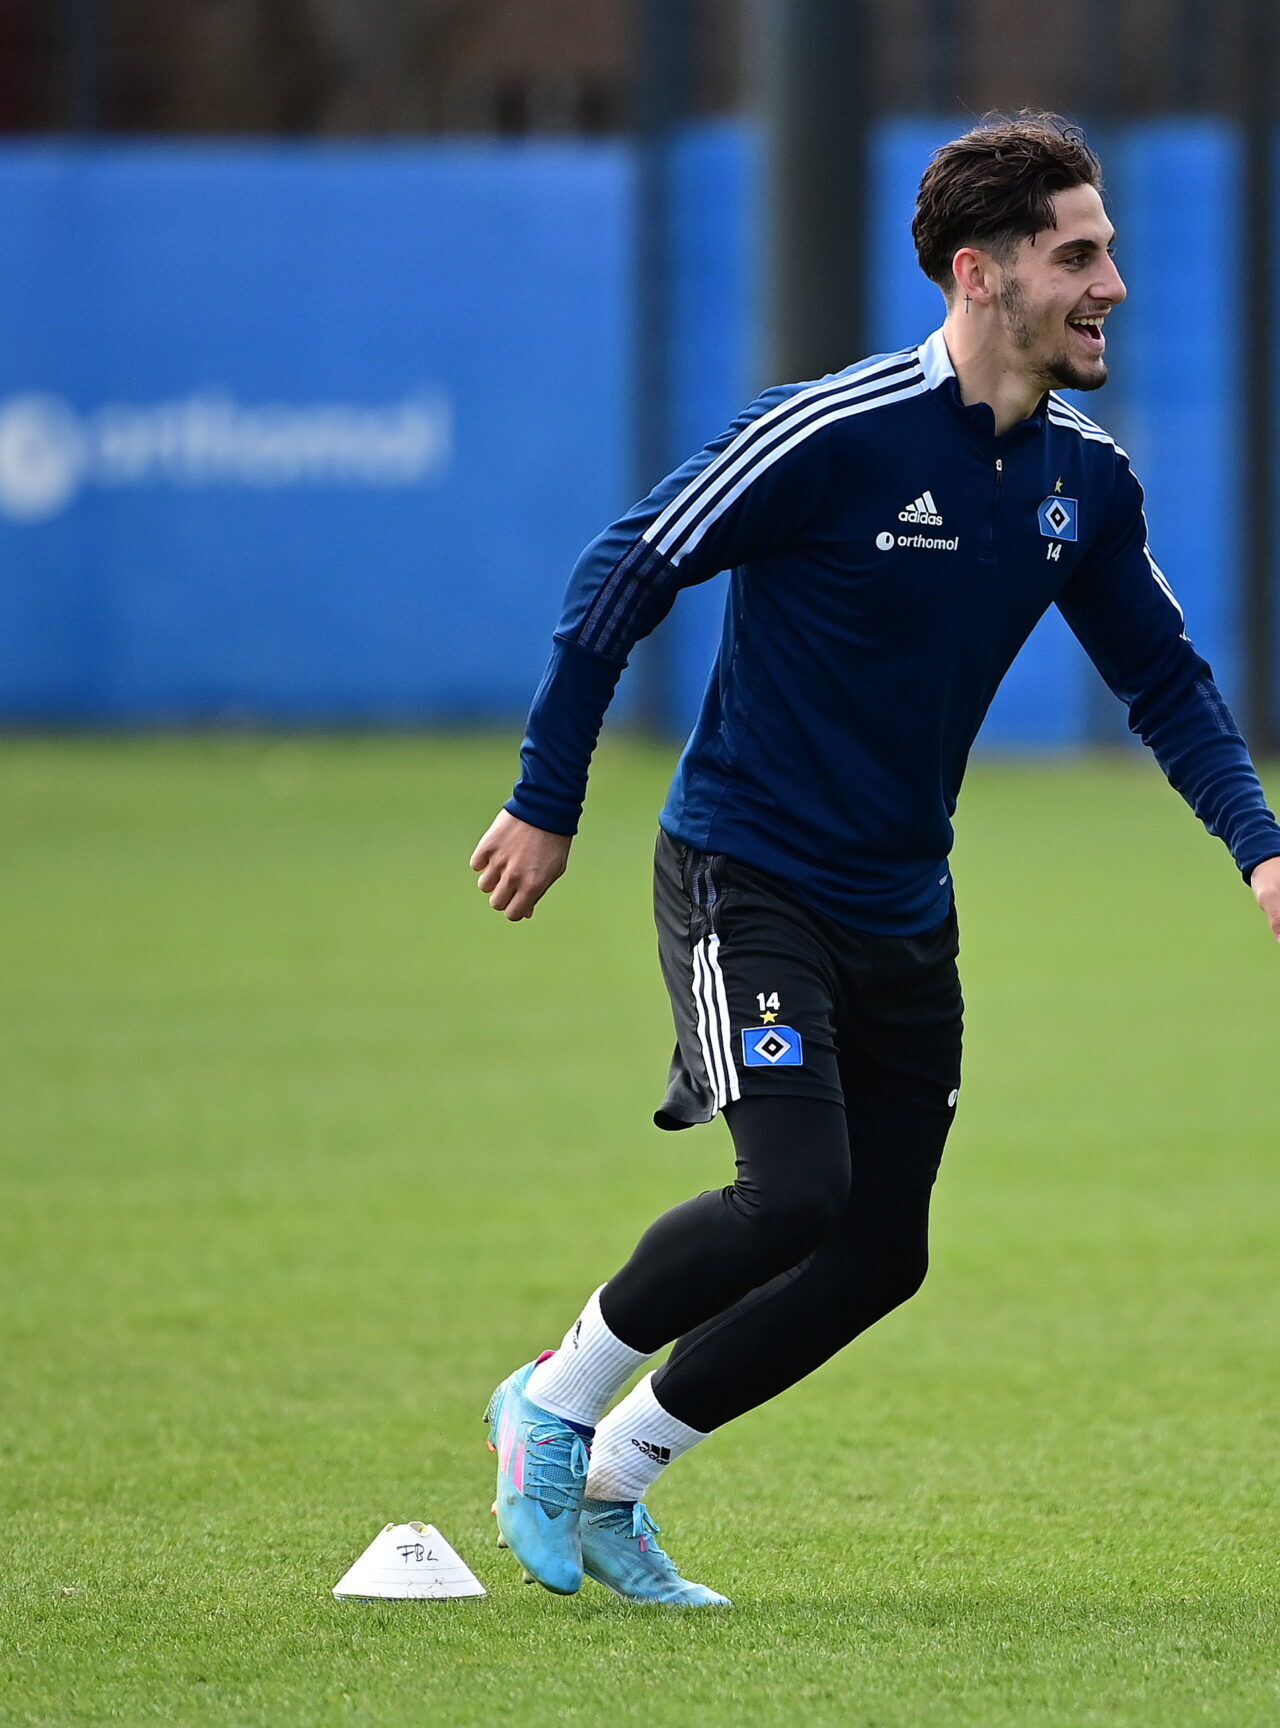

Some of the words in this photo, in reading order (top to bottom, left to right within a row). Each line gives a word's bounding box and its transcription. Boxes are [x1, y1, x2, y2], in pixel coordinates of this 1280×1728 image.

[898, 510, 943, 526] adidas
[897, 534, 959, 551] orthomol
[1046, 542, 1062, 562] 14
[756, 991, 781, 1012] 14
[396, 1543, 439, 1563] FBL
